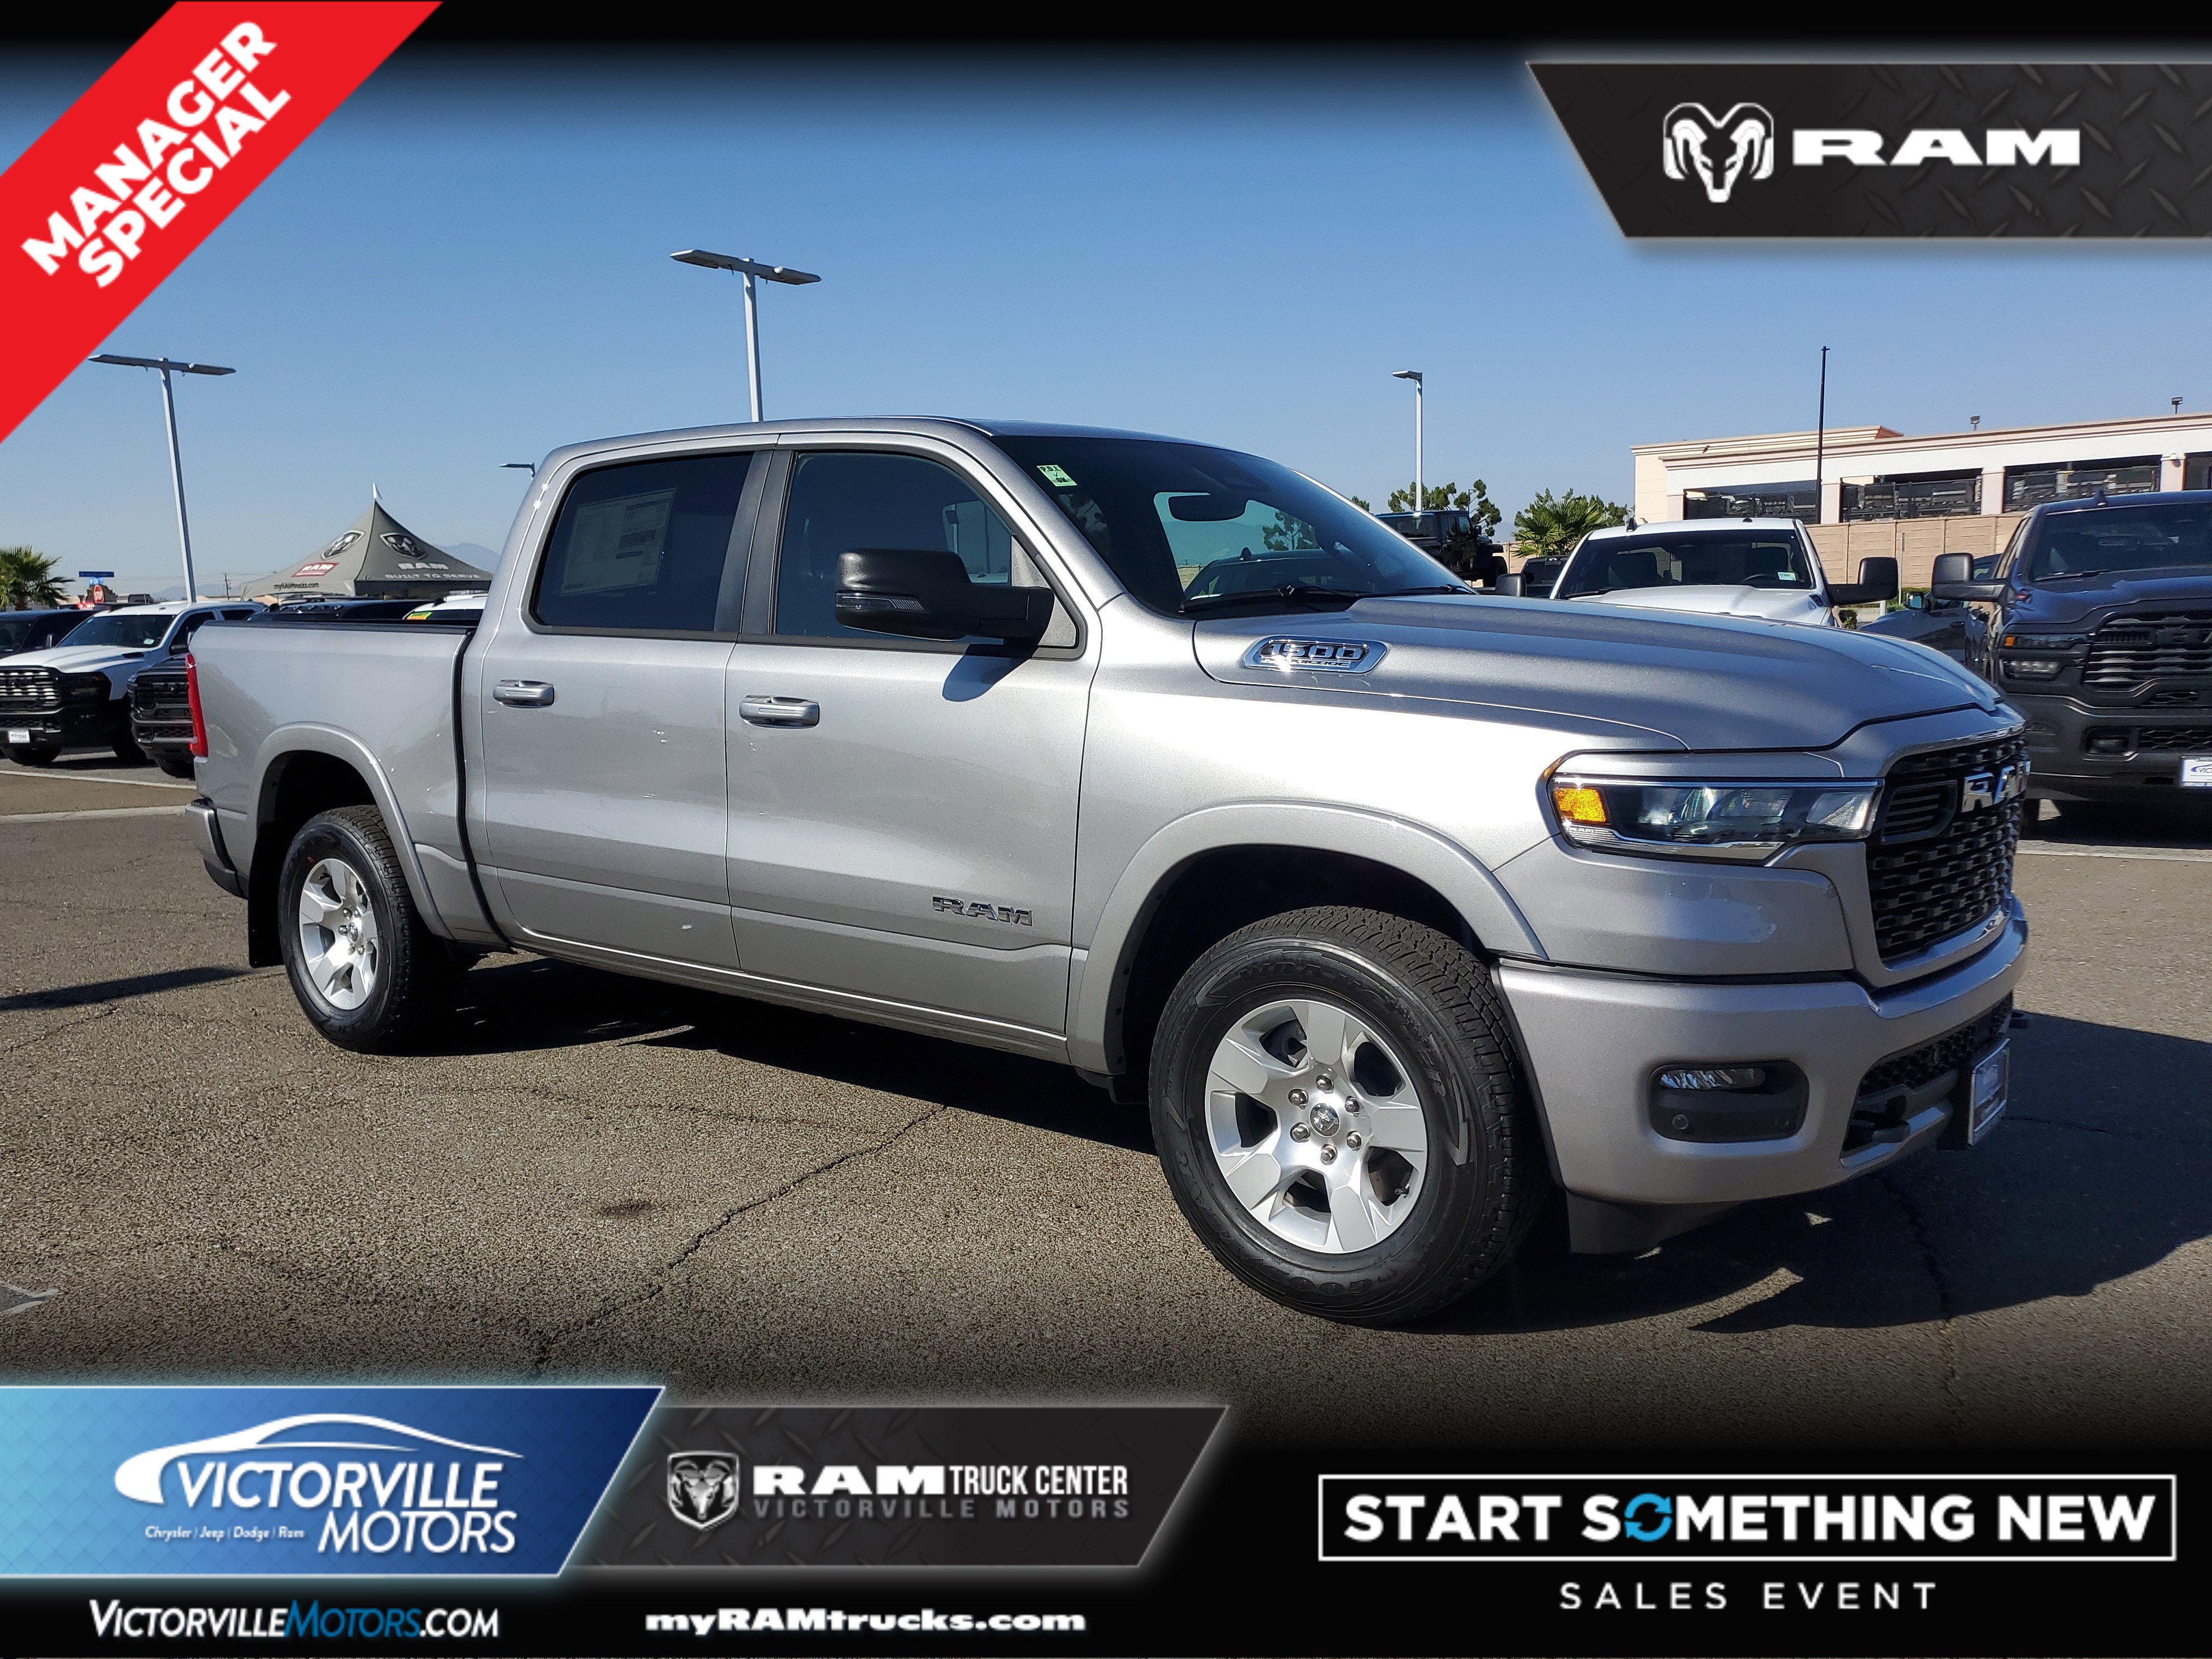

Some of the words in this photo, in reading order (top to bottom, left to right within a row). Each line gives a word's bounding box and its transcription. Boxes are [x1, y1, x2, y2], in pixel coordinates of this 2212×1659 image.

[397, 562, 449, 570] RAM
[1270, 644, 1363, 659] 1500
[932, 895, 1032, 926] RAM
